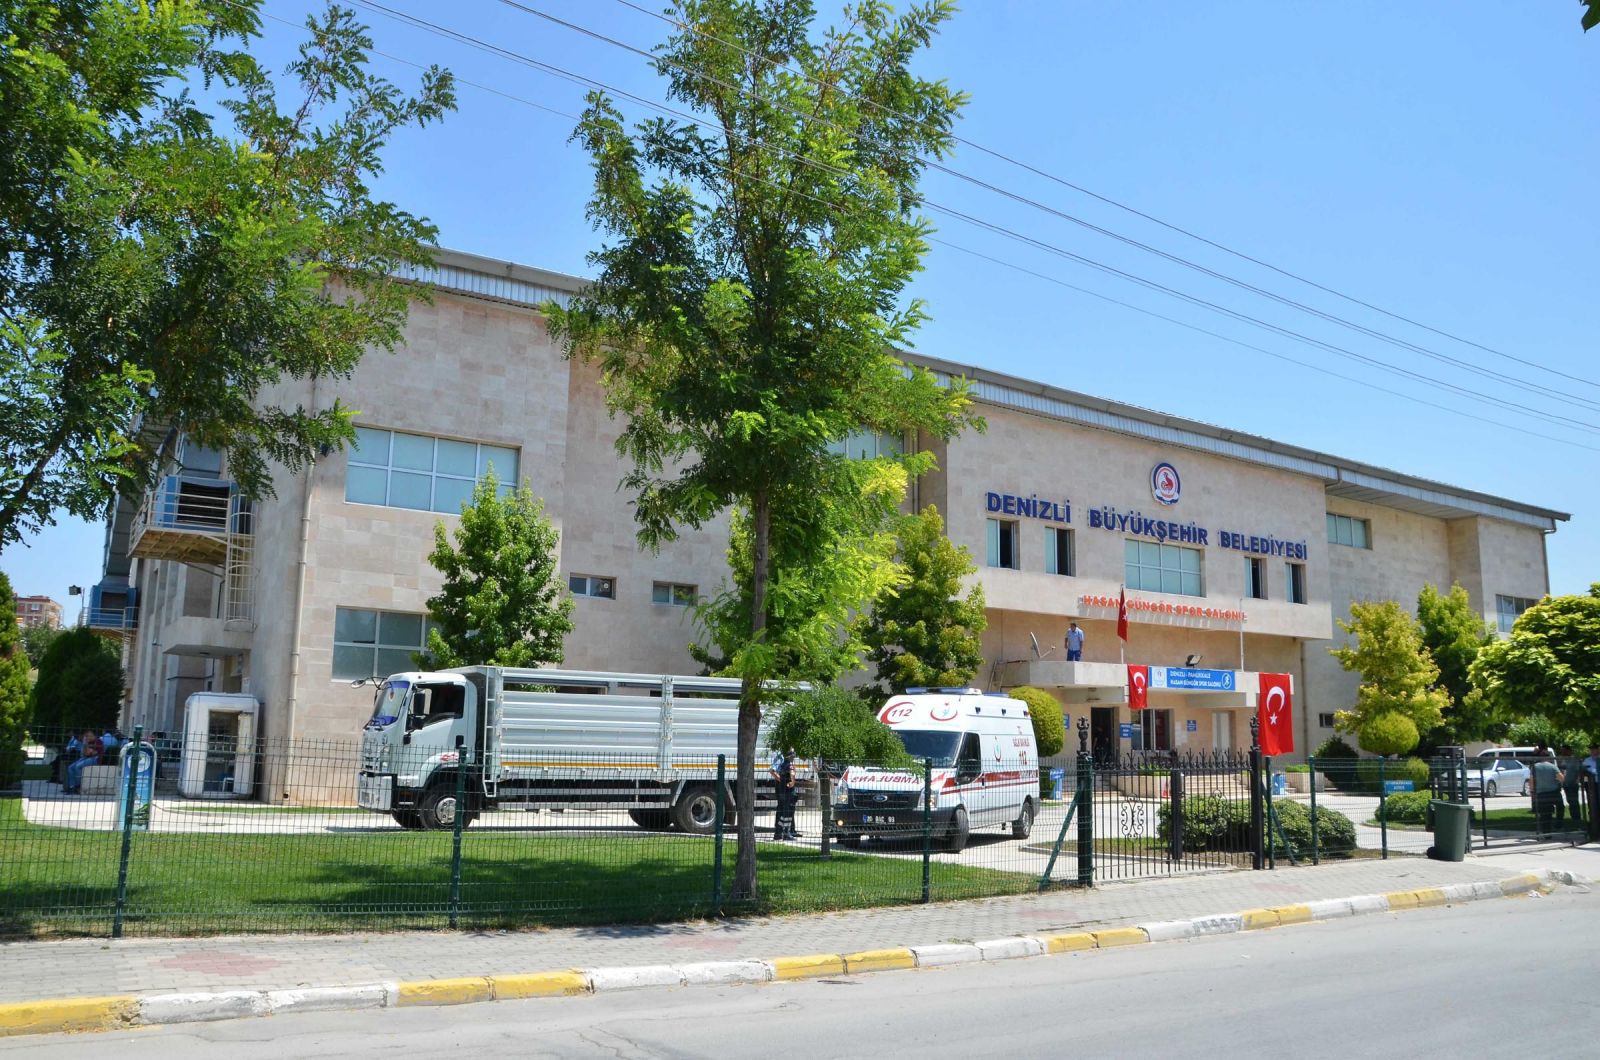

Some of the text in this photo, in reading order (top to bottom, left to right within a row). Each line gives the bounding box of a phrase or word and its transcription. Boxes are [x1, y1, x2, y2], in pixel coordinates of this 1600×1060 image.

[987, 491, 1307, 560] DENİZLİ BÜYÜKŞEHİR BELEDİYESİ
[1175, 605, 1202, 616] SPOR
[891, 708, 913, 717] 112
